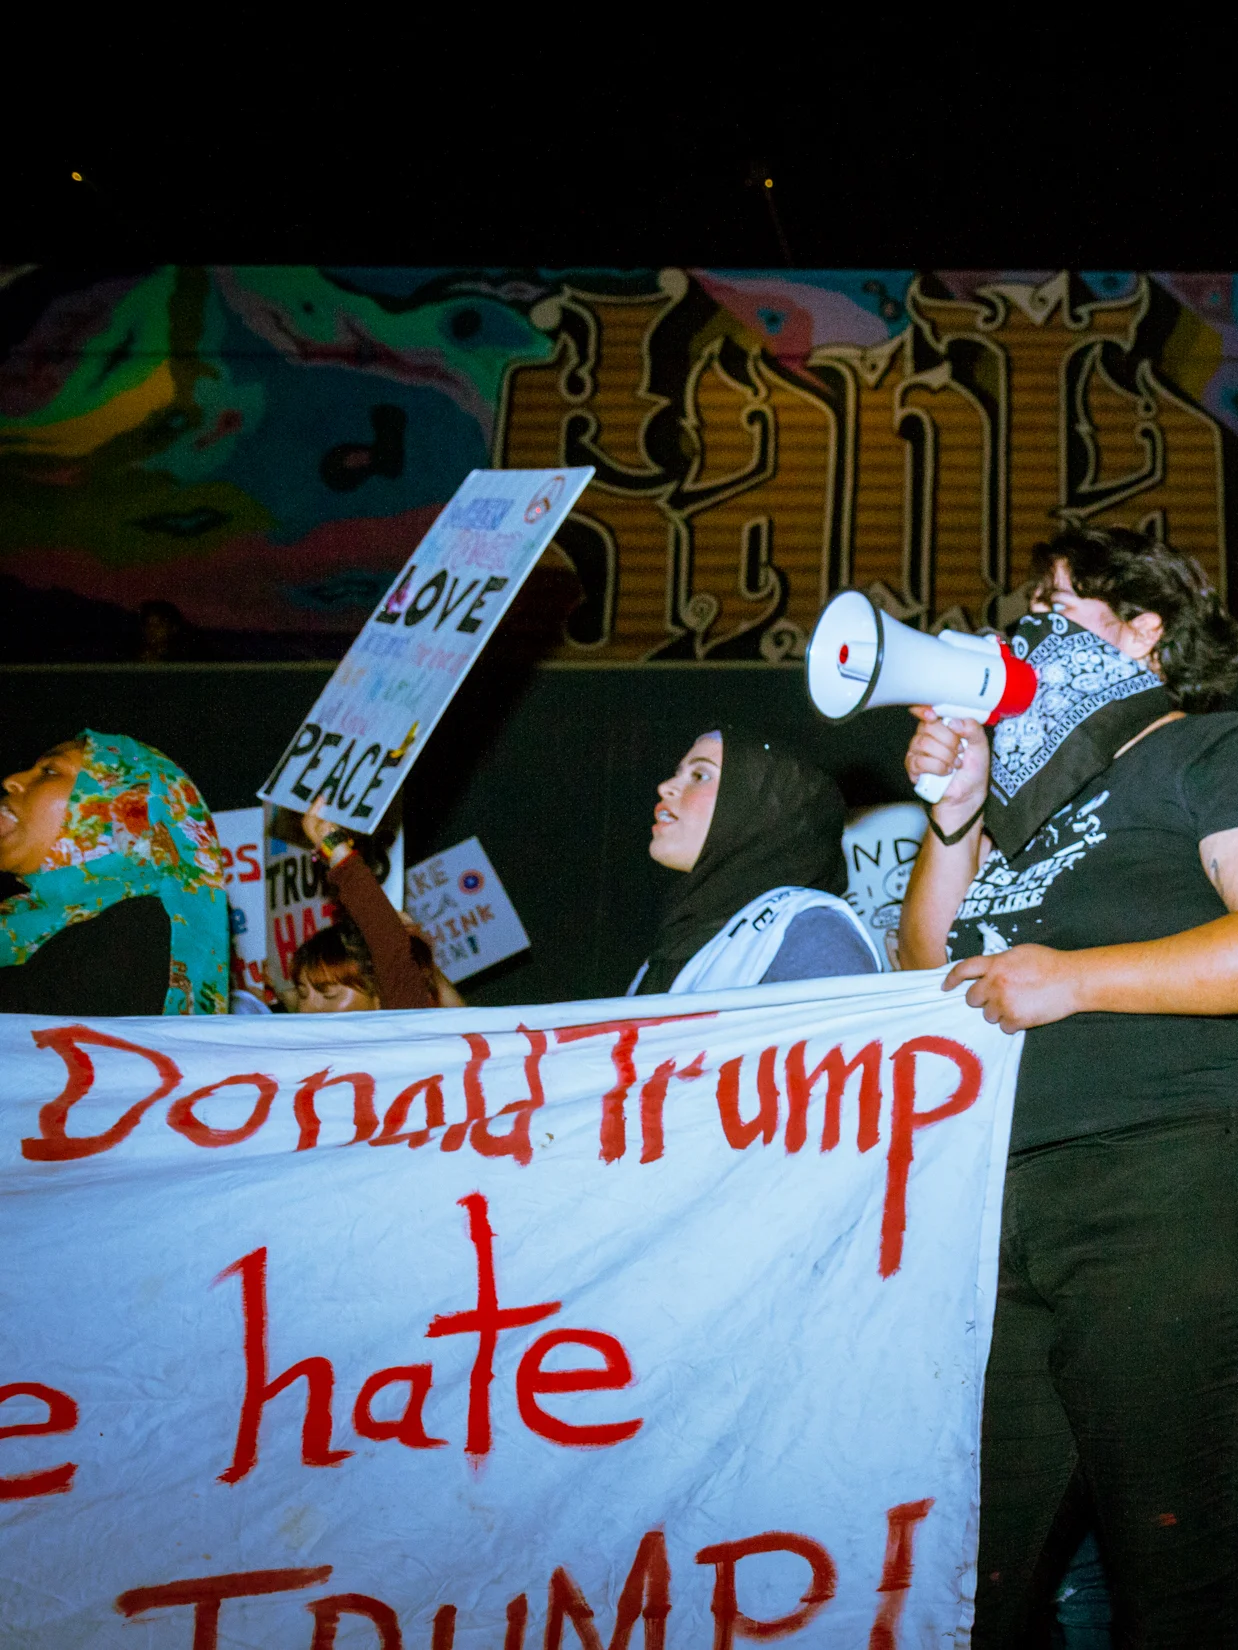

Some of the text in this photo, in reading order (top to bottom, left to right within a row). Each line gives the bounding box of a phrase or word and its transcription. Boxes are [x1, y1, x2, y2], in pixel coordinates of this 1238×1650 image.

[375, 565, 509, 634] LOVE
[264, 723, 404, 818] PEACE
[20, 1012, 984, 1280] Donald Trump
[212, 1193, 645, 1486] hate
